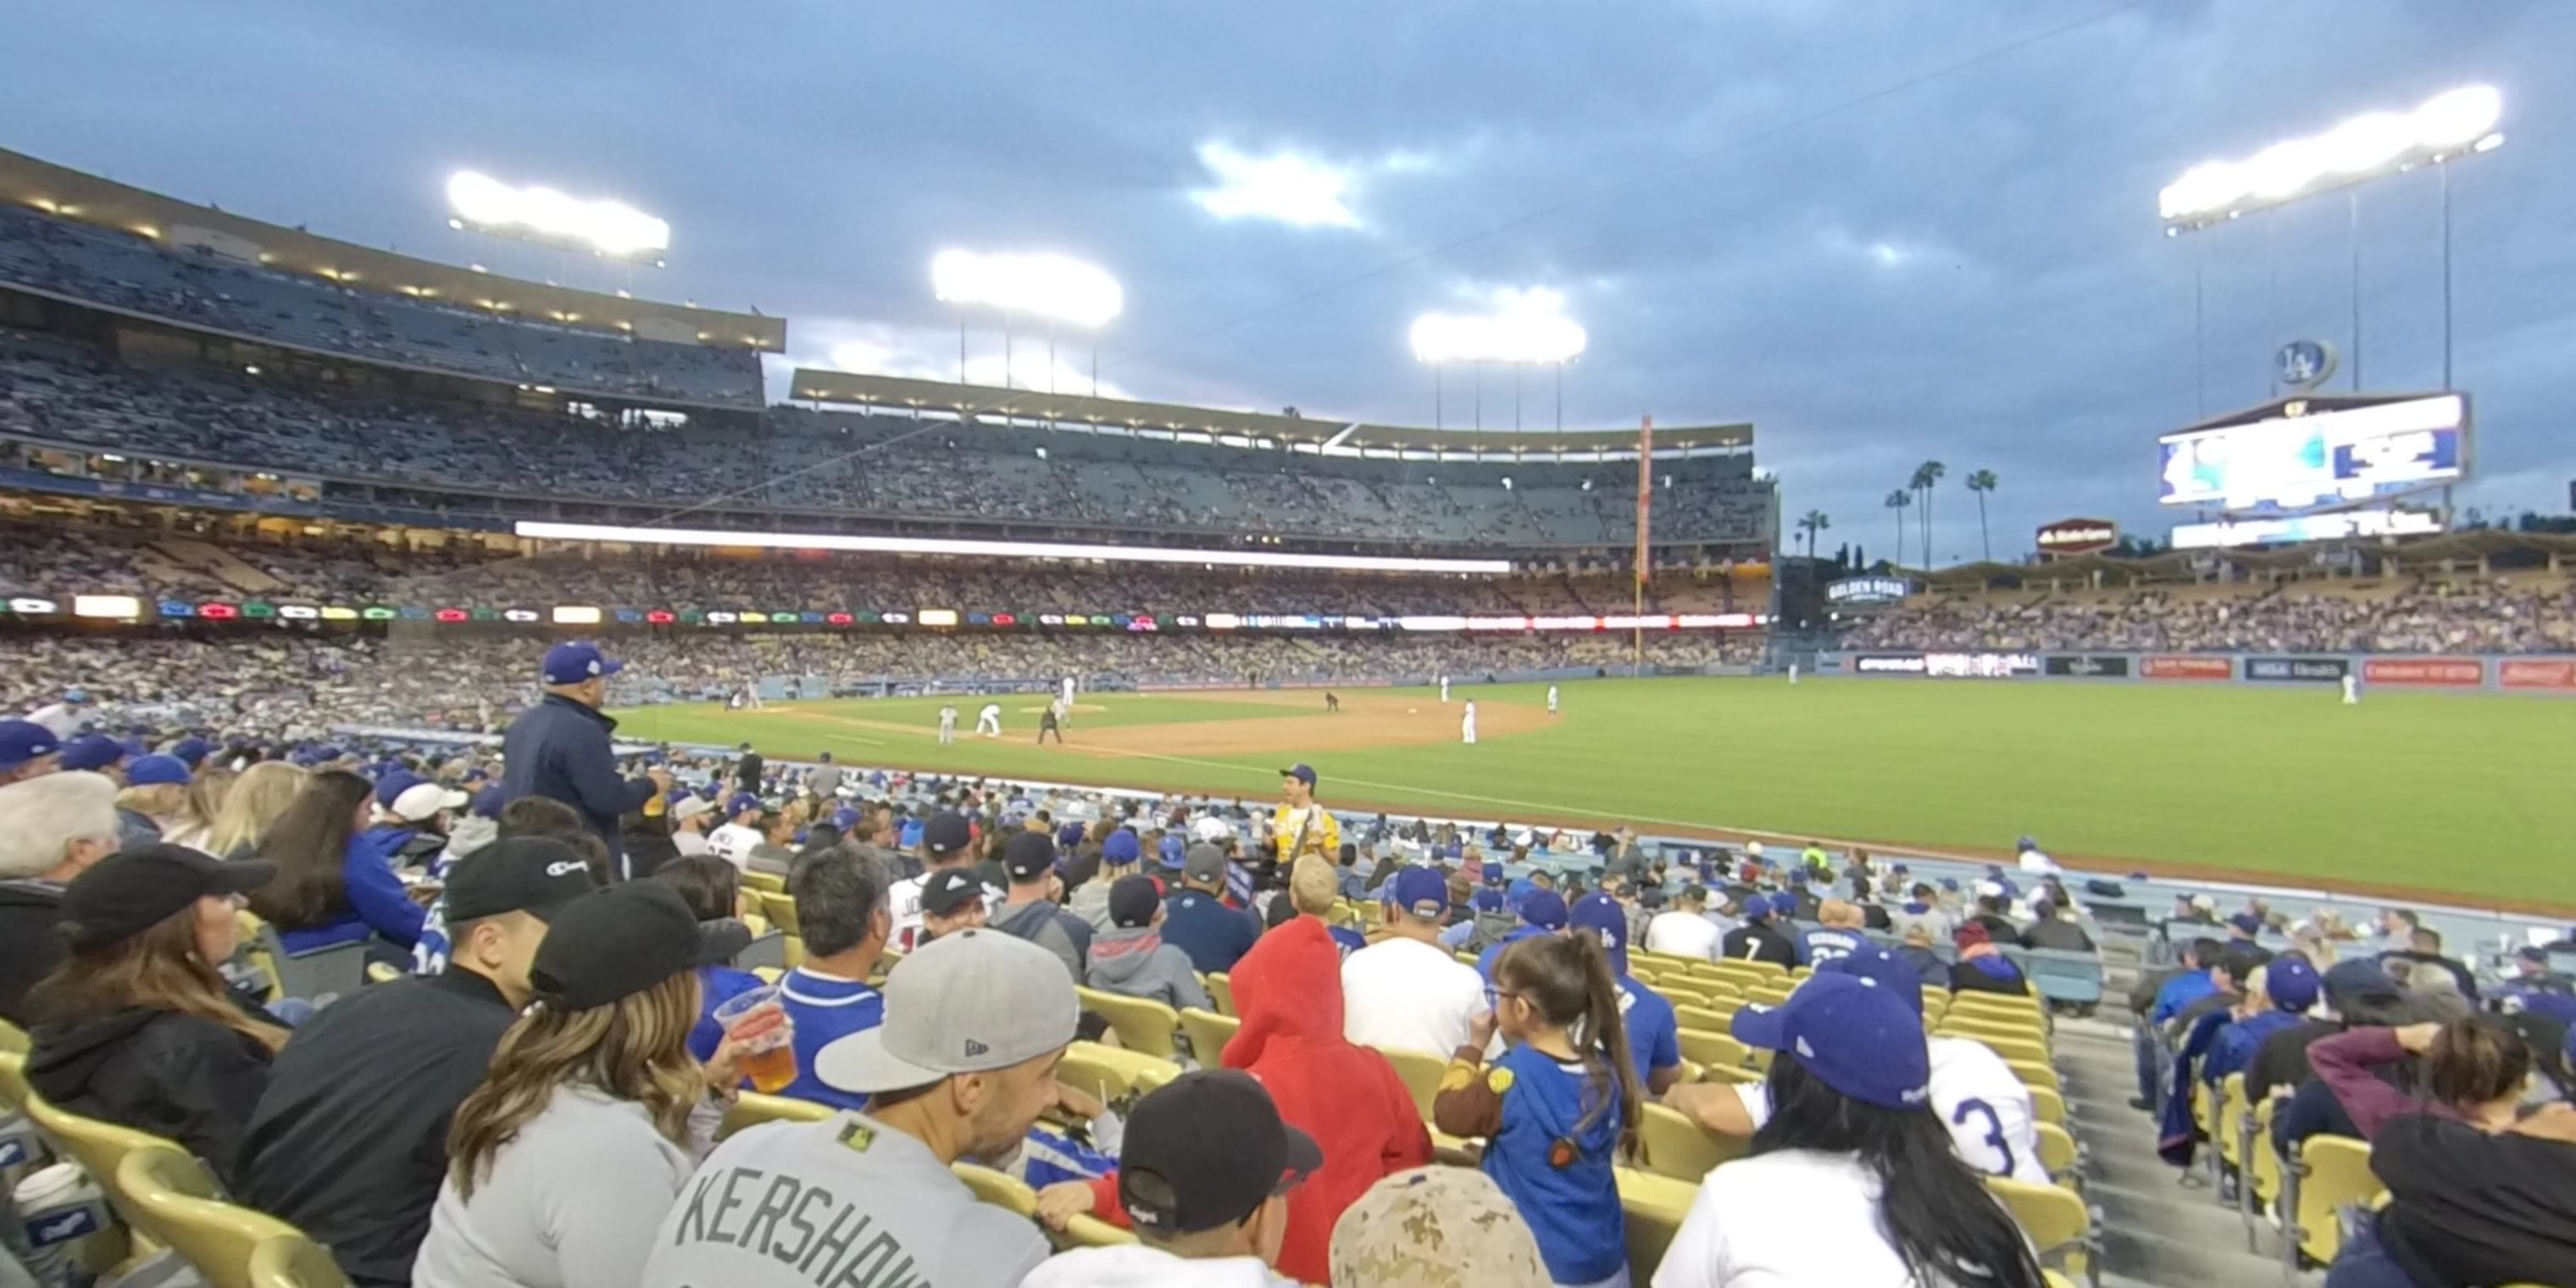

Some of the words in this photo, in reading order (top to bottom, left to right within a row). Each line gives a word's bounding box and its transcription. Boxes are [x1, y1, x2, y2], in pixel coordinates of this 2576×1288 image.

[2285, 348, 2313, 379] LA
[1829, 581, 1871, 599] GOLDEN
[1874, 580, 1904, 597] ROAD
[1746, 936, 1762, 962] 7
[1952, 1096, 2015, 1177] 3
